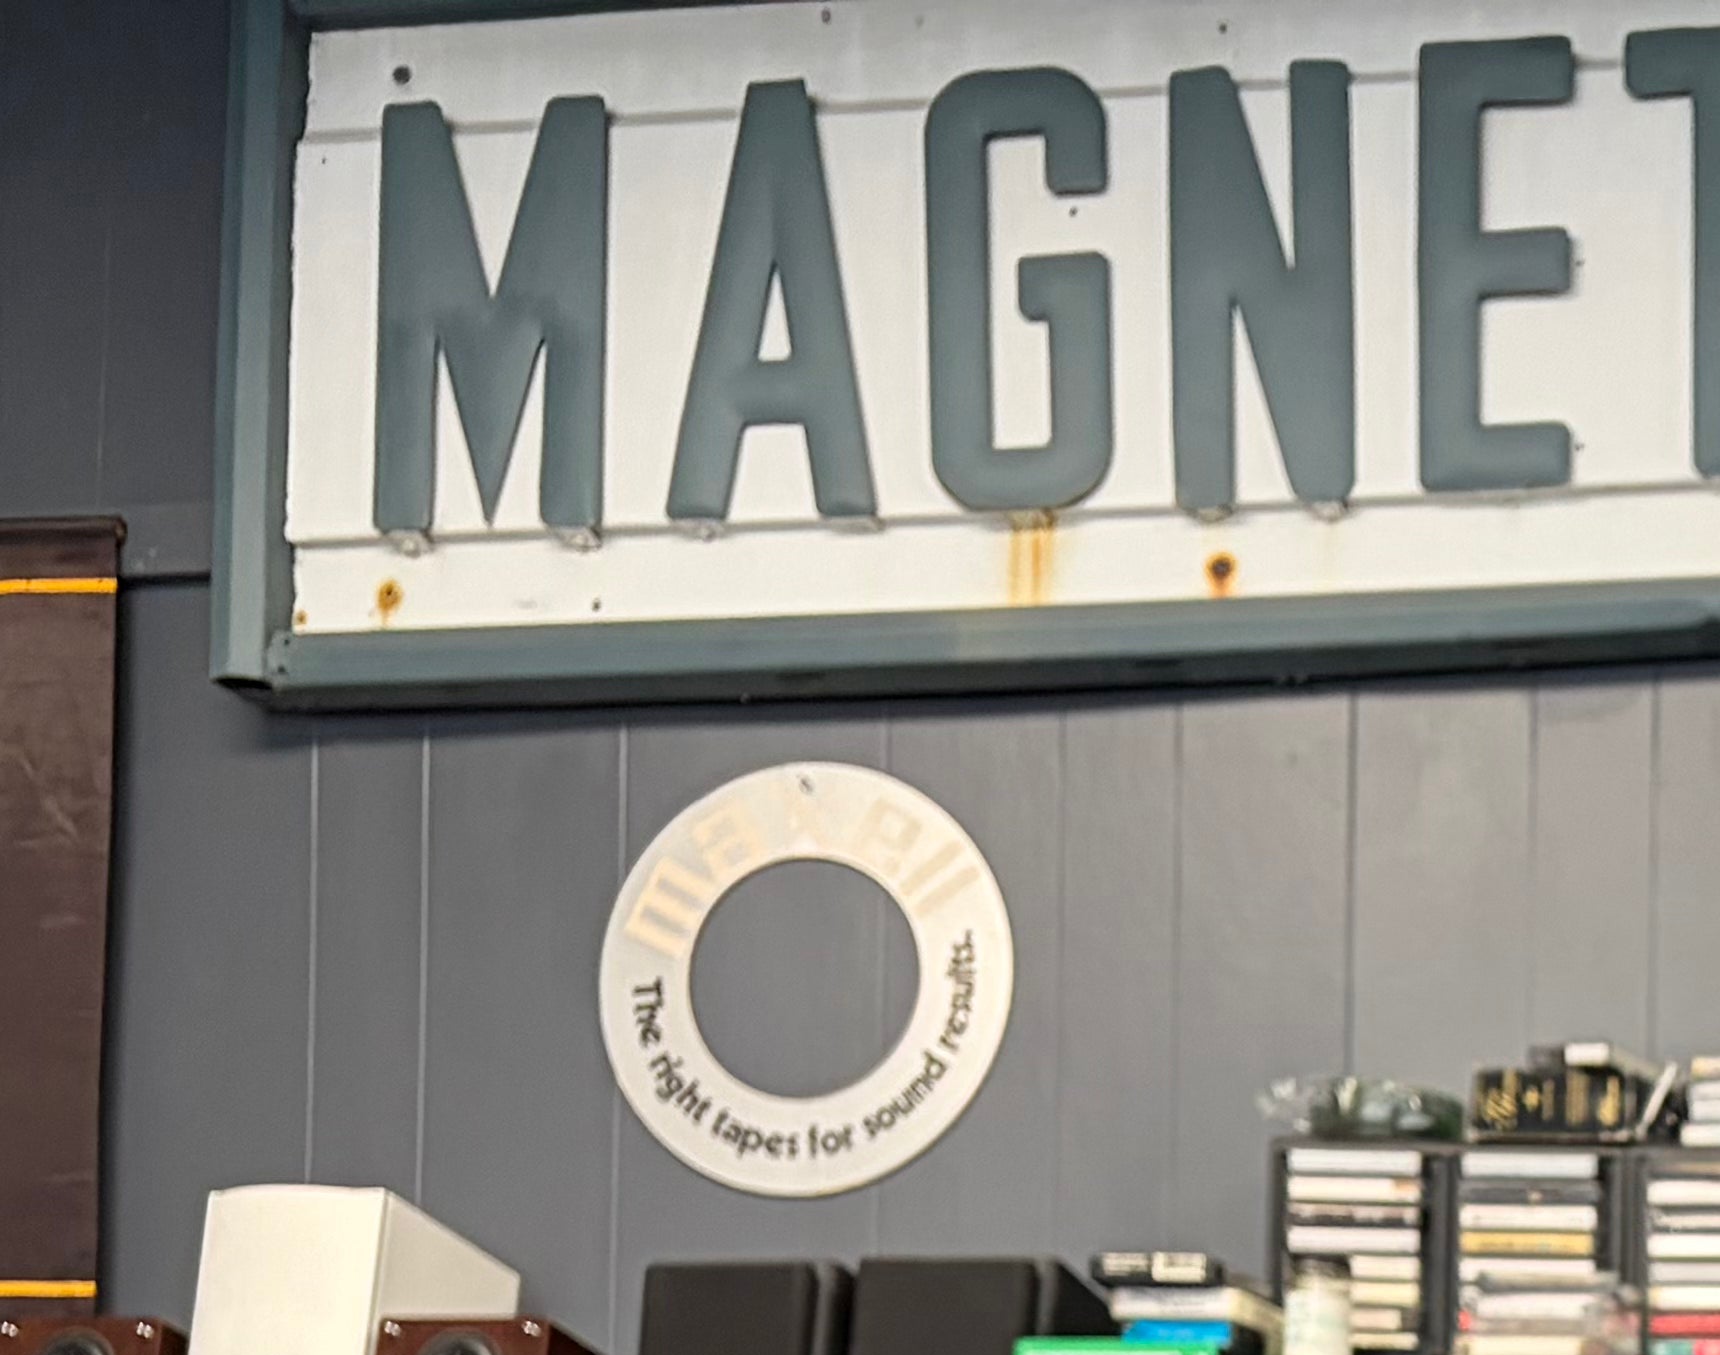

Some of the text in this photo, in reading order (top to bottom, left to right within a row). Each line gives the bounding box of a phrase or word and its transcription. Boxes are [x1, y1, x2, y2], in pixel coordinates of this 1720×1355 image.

[632, 974, 664, 1047] The
[649, 1050, 711, 1123] right
[711, 1108, 800, 1159] tapes
[808, 1121, 853, 1157] for
[862, 1050, 947, 1137] sound
